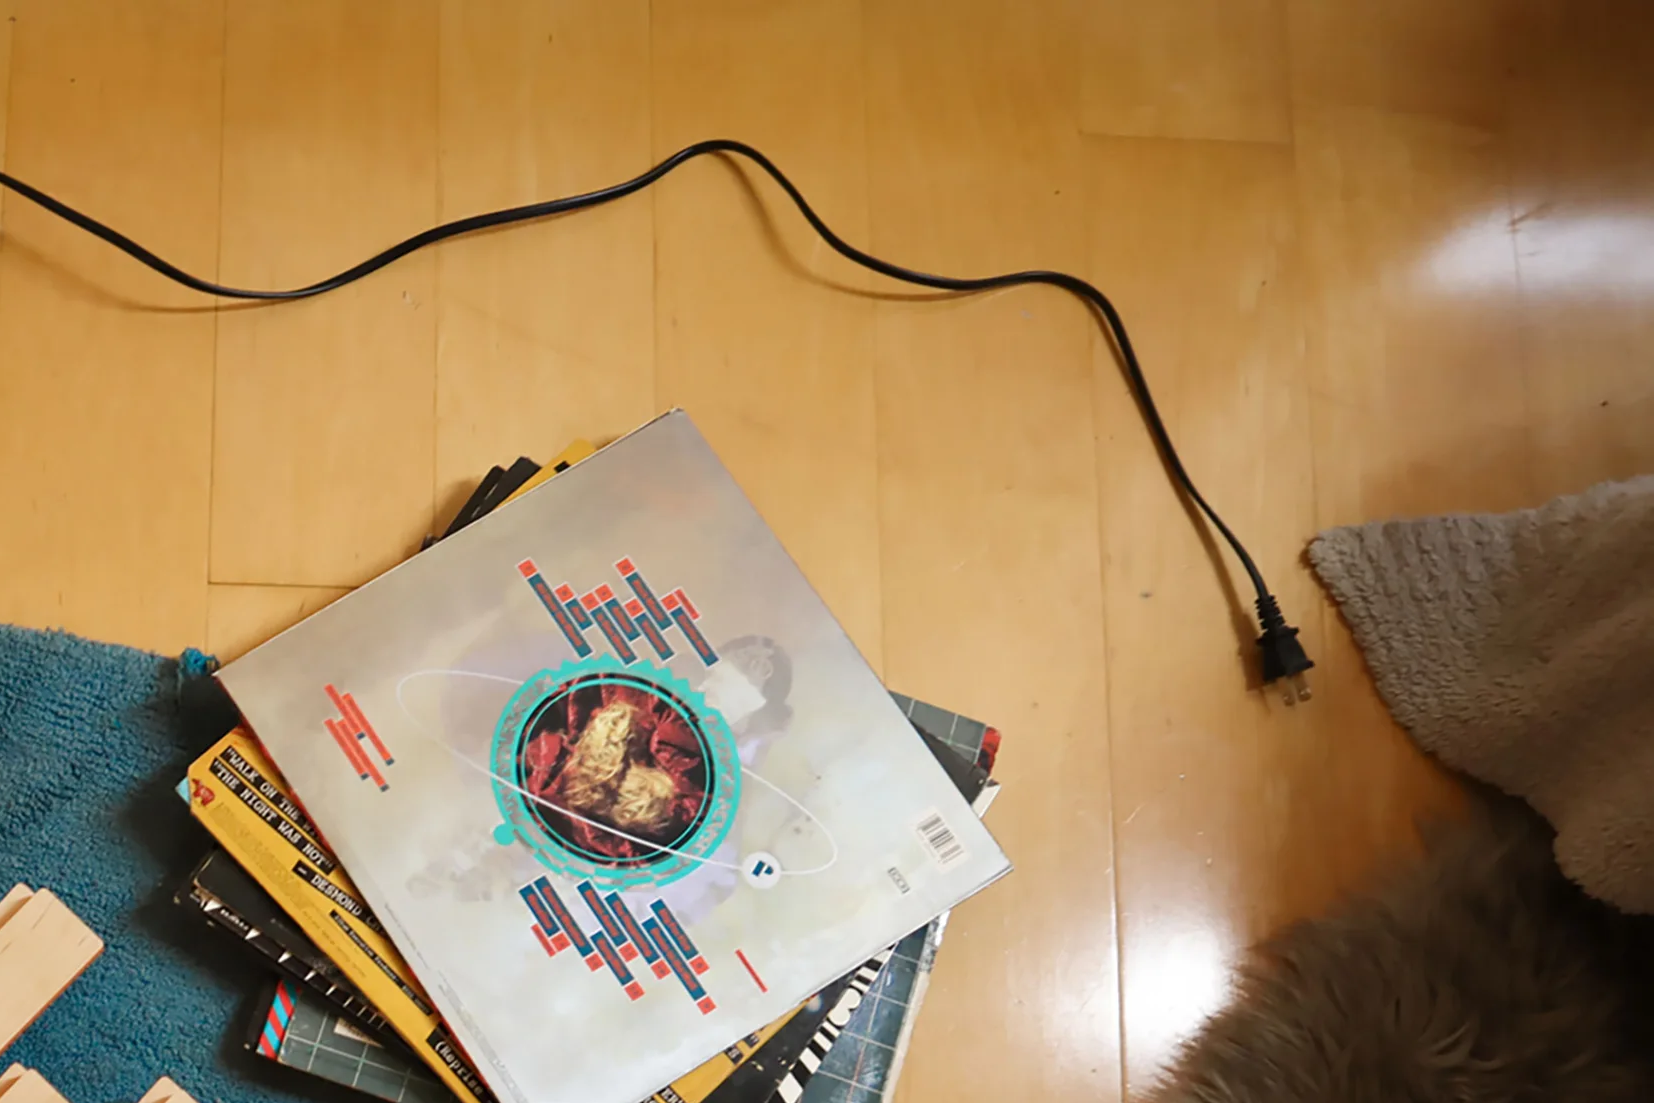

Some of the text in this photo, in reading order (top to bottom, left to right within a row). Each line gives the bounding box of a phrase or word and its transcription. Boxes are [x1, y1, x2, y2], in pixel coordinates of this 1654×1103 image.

[213, 760, 237, 790] "THE
[240, 789, 278, 821] NIGHT
[277, 820, 302, 844] WAS
[302, 842, 333, 869] NOT"
[259, 778, 279, 799] ON
[279, 798, 302, 821] THE
[310, 874, 363, 917] DESMOND
